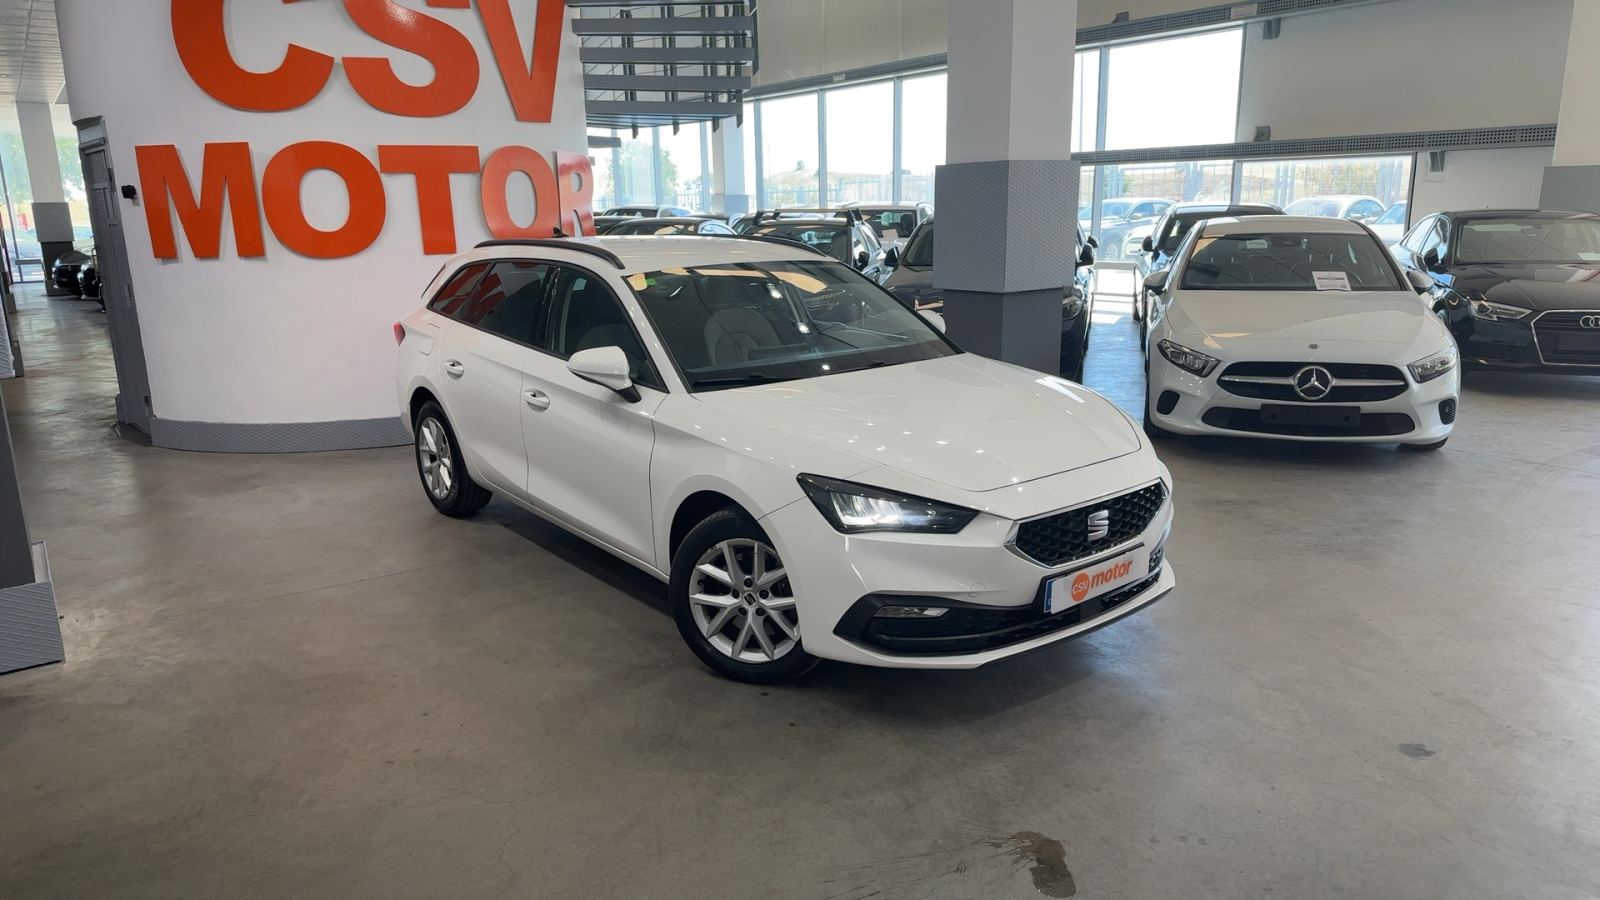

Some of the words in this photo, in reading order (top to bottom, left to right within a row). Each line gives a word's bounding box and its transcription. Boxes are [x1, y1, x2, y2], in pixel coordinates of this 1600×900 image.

[170, 0, 564, 123] CSV
[135, 141, 595, 259] MOTOR
[1091, 560, 1133, 589] motor
